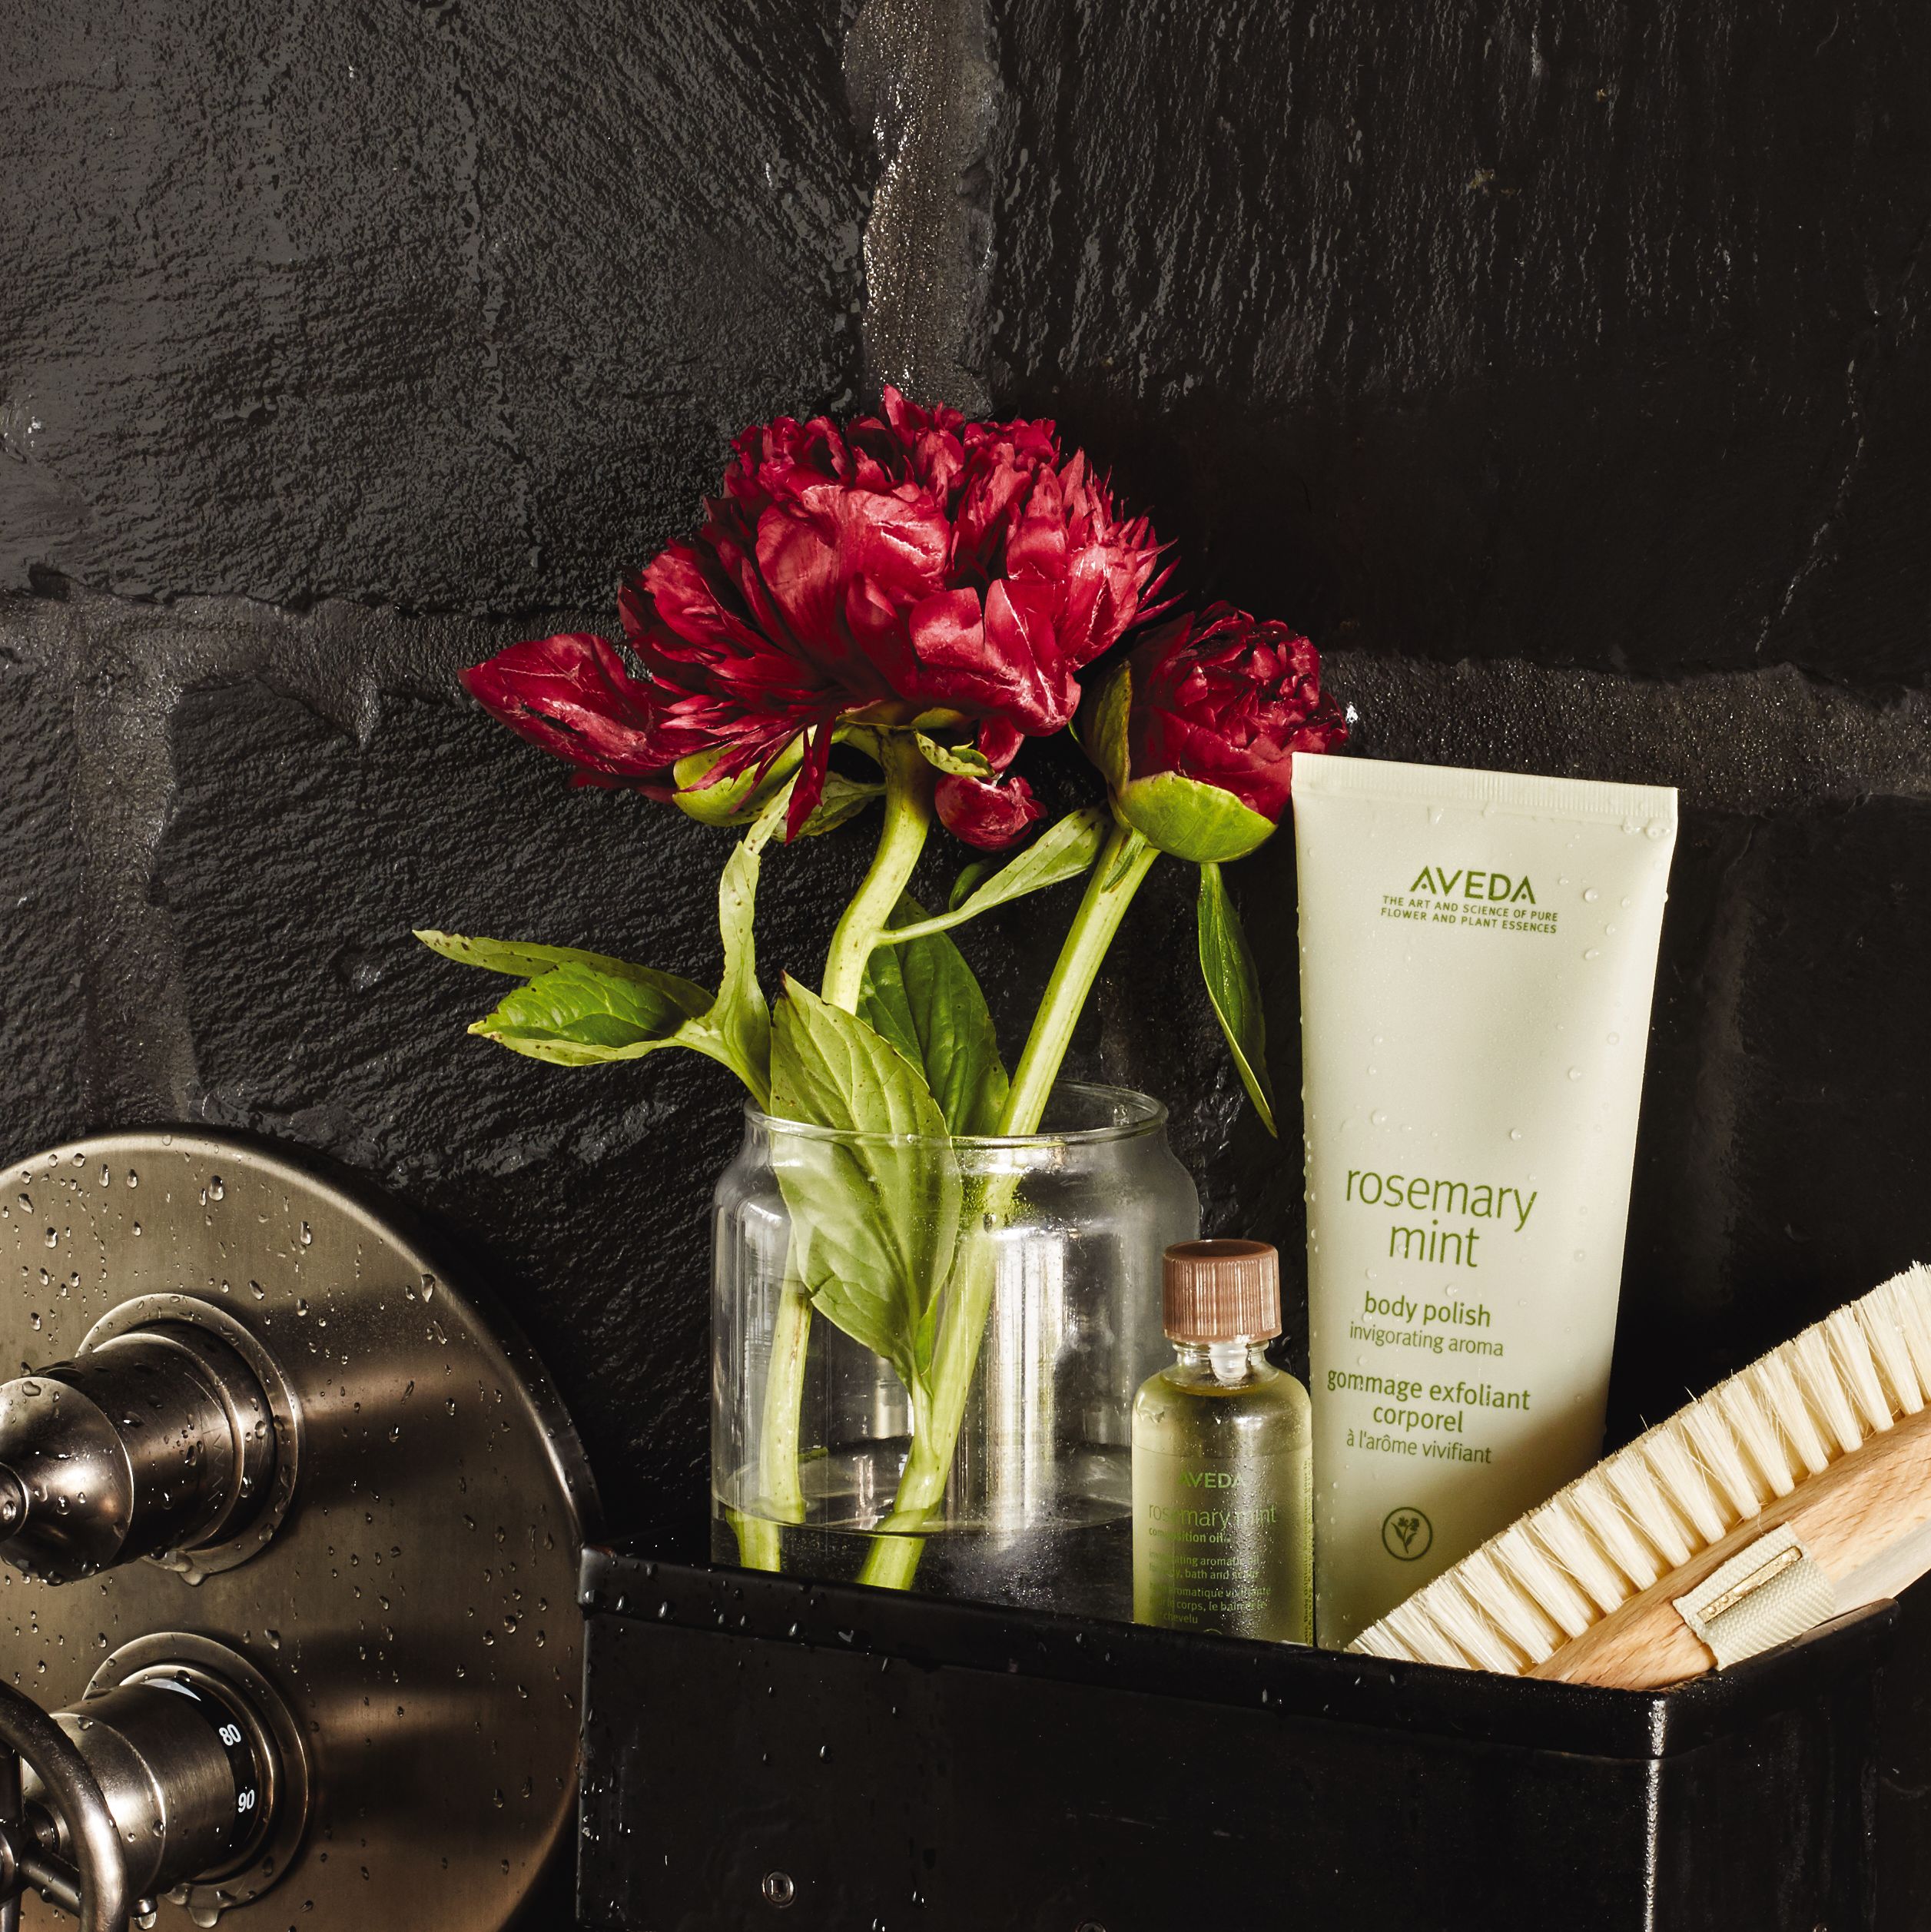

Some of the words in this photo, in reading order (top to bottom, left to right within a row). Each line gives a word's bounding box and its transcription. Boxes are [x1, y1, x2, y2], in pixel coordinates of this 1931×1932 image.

[1409, 865, 1536, 905] AVEDA
[1381, 908, 1427, 921] FLOWER
[1432, 913, 1456, 924] AND
[1461, 916, 1498, 928] PLANT
[1502, 920, 1557, 934] ESSENCES
[1383, 895, 1404, 907] THE
[1408, 898, 1431, 910] ART
[1435, 902, 1458, 912] AND
[1463, 905, 1509, 918] SCIENCE
[1513, 909, 1527, 918] OF
[1531, 911, 1558, 922] PURE
[1346, 1170, 1538, 1233] rosemary
[1389, 1220, 1480, 1268] mint
[1365, 1291, 1417, 1323] body
[1423, 1302, 1491, 1327] polish
[1349, 1322, 1445, 1354] invigorating
[1448, 1336, 1504, 1357] aroma
[1327, 1369, 1422, 1403] gommage
[1429, 1381, 1531, 1411] exfoliant
[1373, 1406, 1464, 1434] corporel
[1346, 1429, 1355, 1447] à
[1359, 1432, 1417, 1456] l'arôme
[1422, 1442, 1491, 1465] vivifiant
[1149, 1503, 1230, 1531] rosmary
[218, 1724, 241, 1746] 80
[238, 1789, 255, 1813] 90
